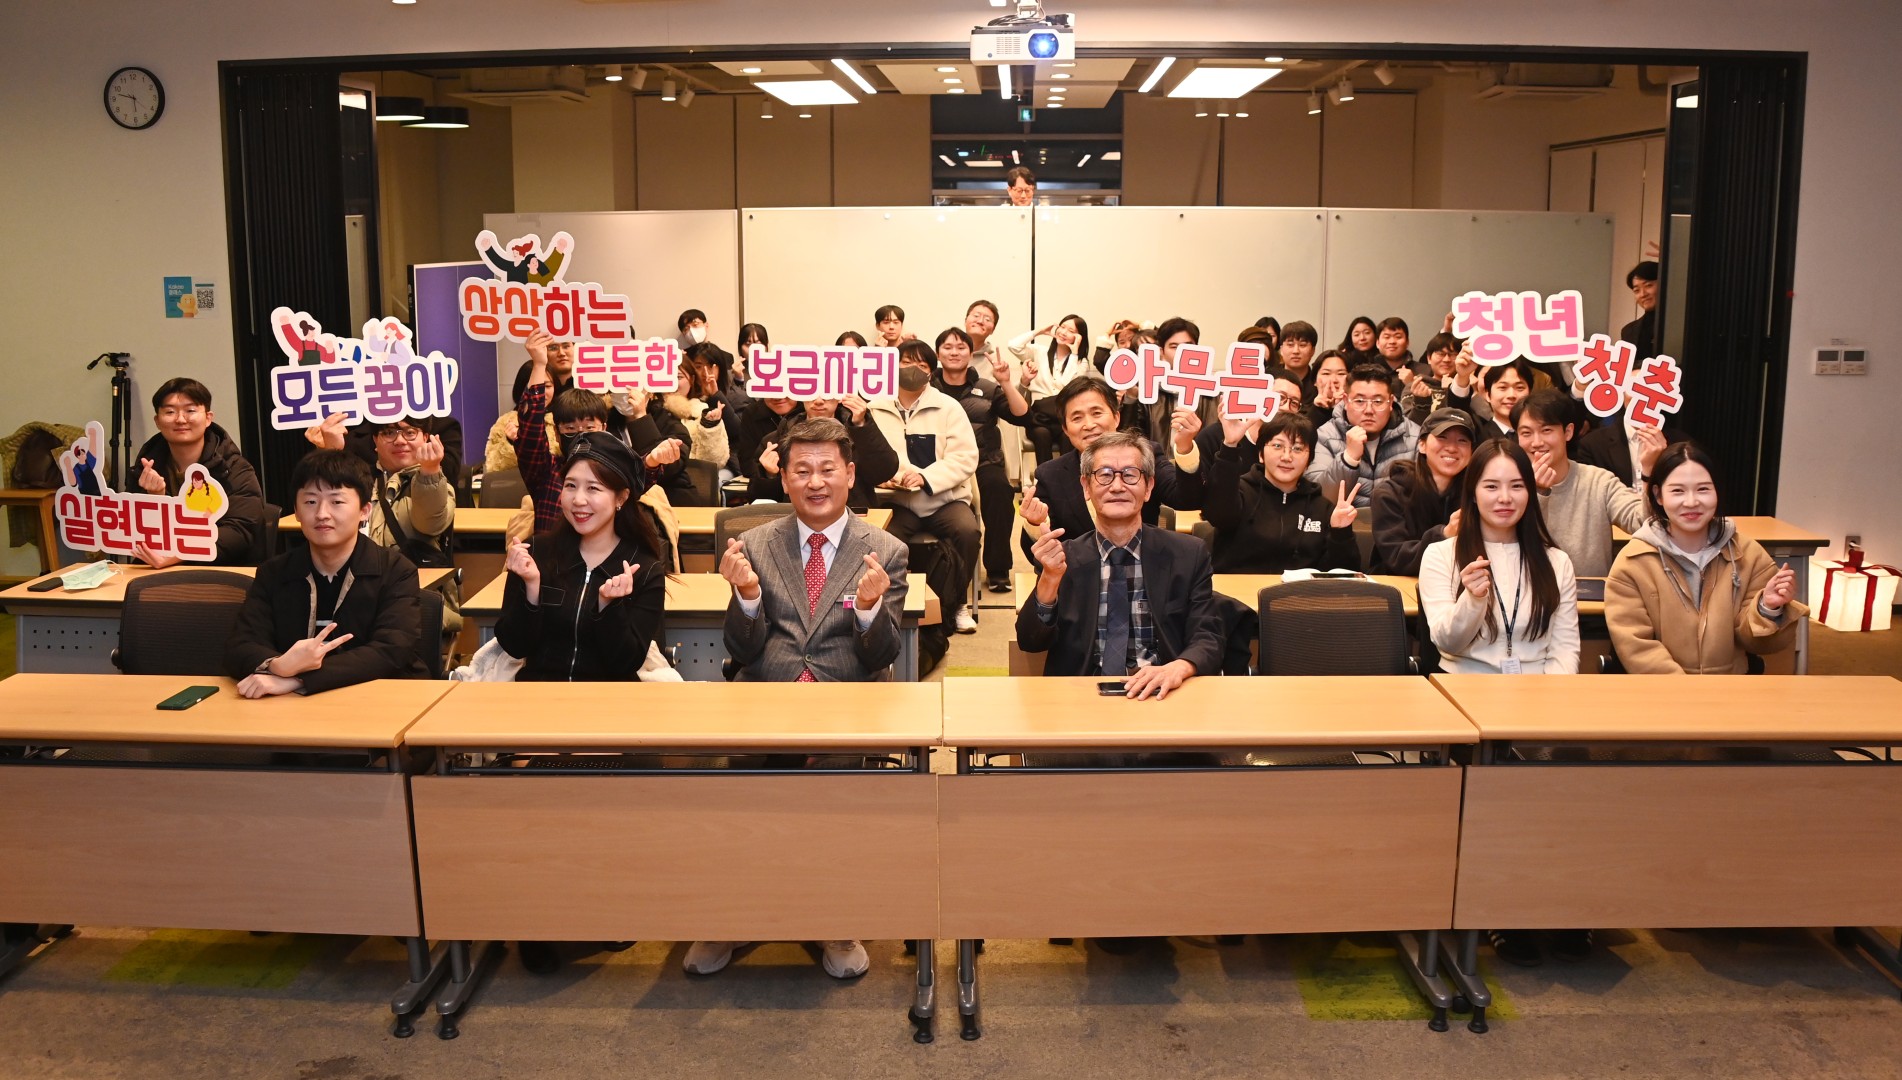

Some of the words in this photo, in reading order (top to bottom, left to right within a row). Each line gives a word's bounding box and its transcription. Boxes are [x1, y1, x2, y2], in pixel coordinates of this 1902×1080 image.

[464, 285, 627, 339] 상상하는
[1458, 296, 1579, 361] 청년
[277, 367, 358, 423] 모든
[364, 361, 446, 417] 꿈이
[576, 342, 678, 388] 든든한
[751, 349, 895, 396] 보금자리
[1110, 347, 1275, 417] 아무튼,
[1579, 339, 1678, 427] 청춘
[60, 493, 212, 556] 실현되는
